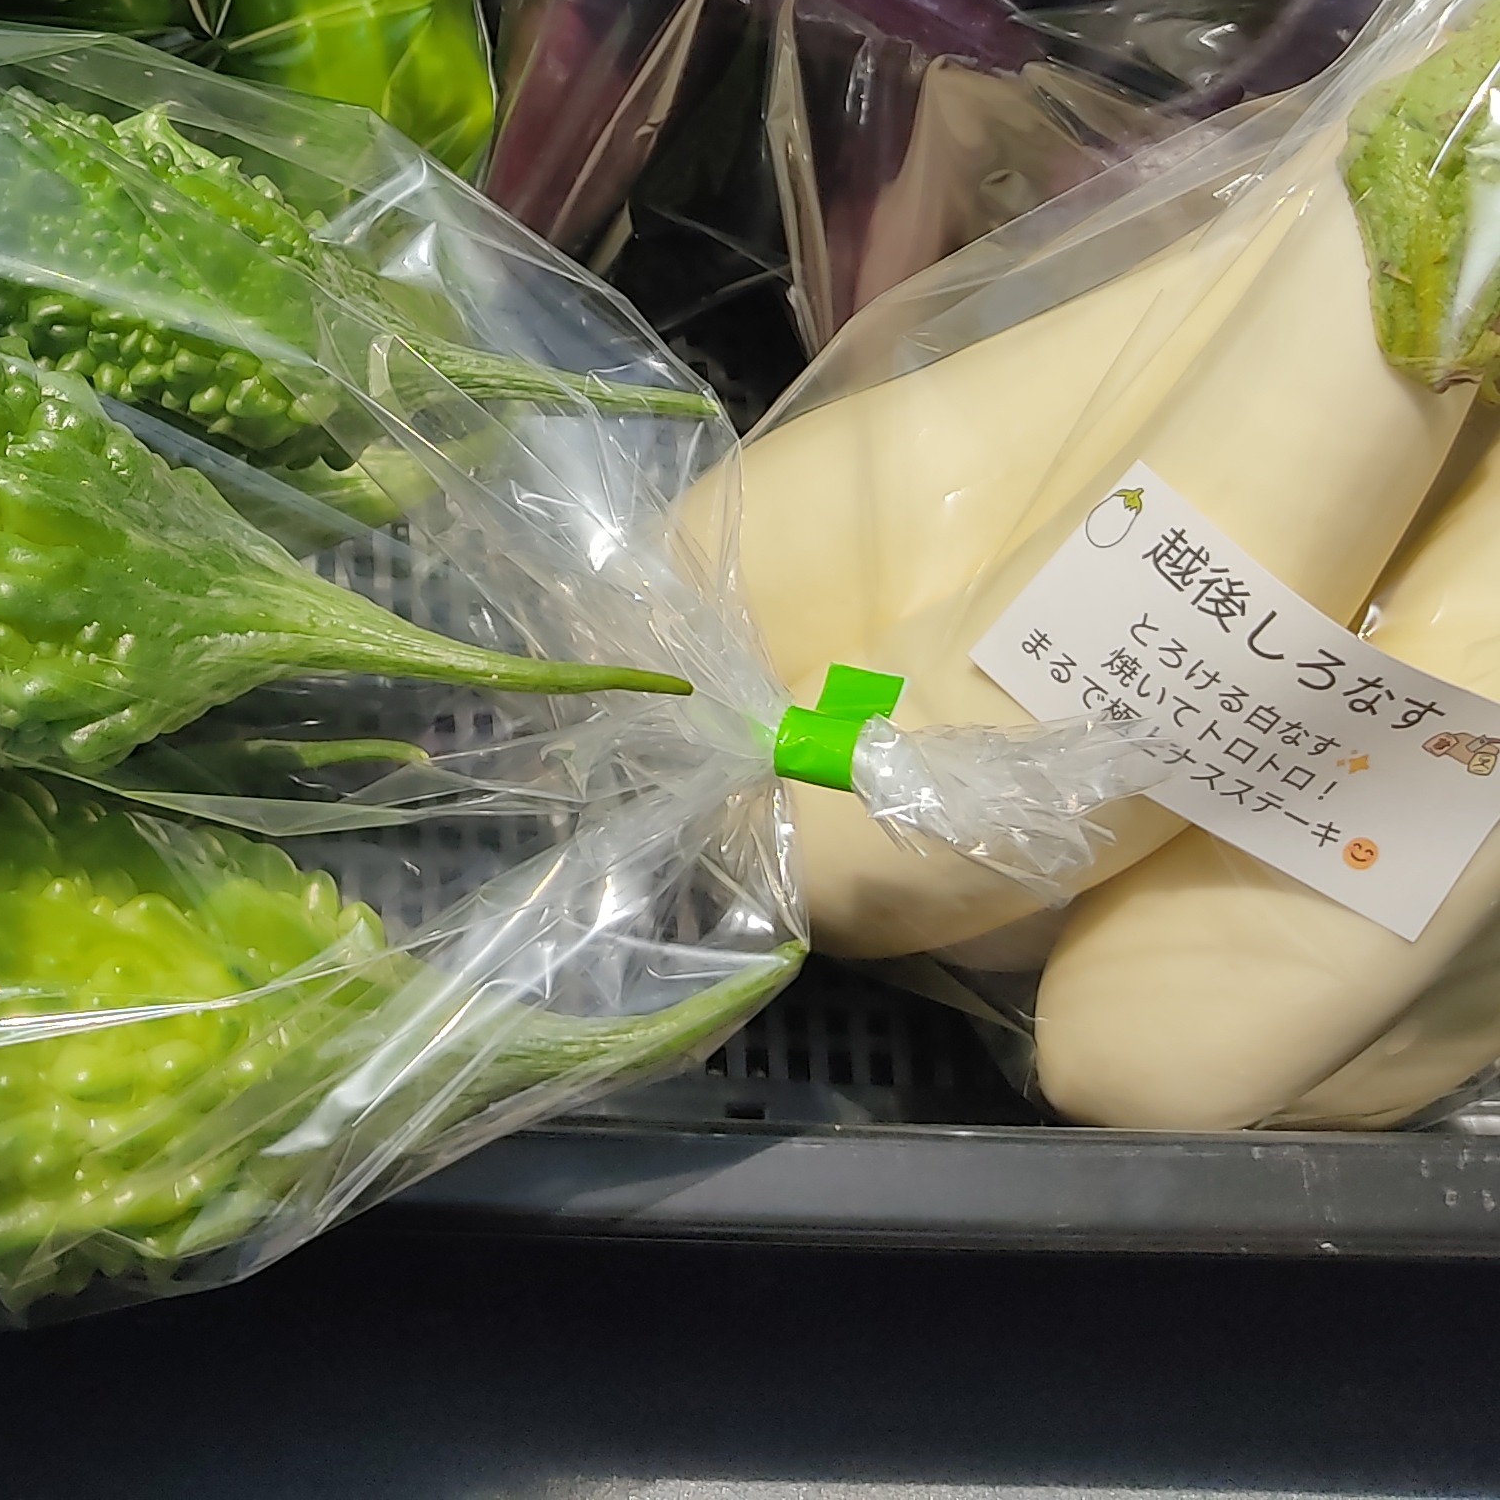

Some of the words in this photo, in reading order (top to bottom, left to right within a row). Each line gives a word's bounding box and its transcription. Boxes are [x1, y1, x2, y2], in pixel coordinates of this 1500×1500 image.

[1129, 613, 1341, 757] とろける白なす
[1141, 527, 1446, 731] 越後しろなす
